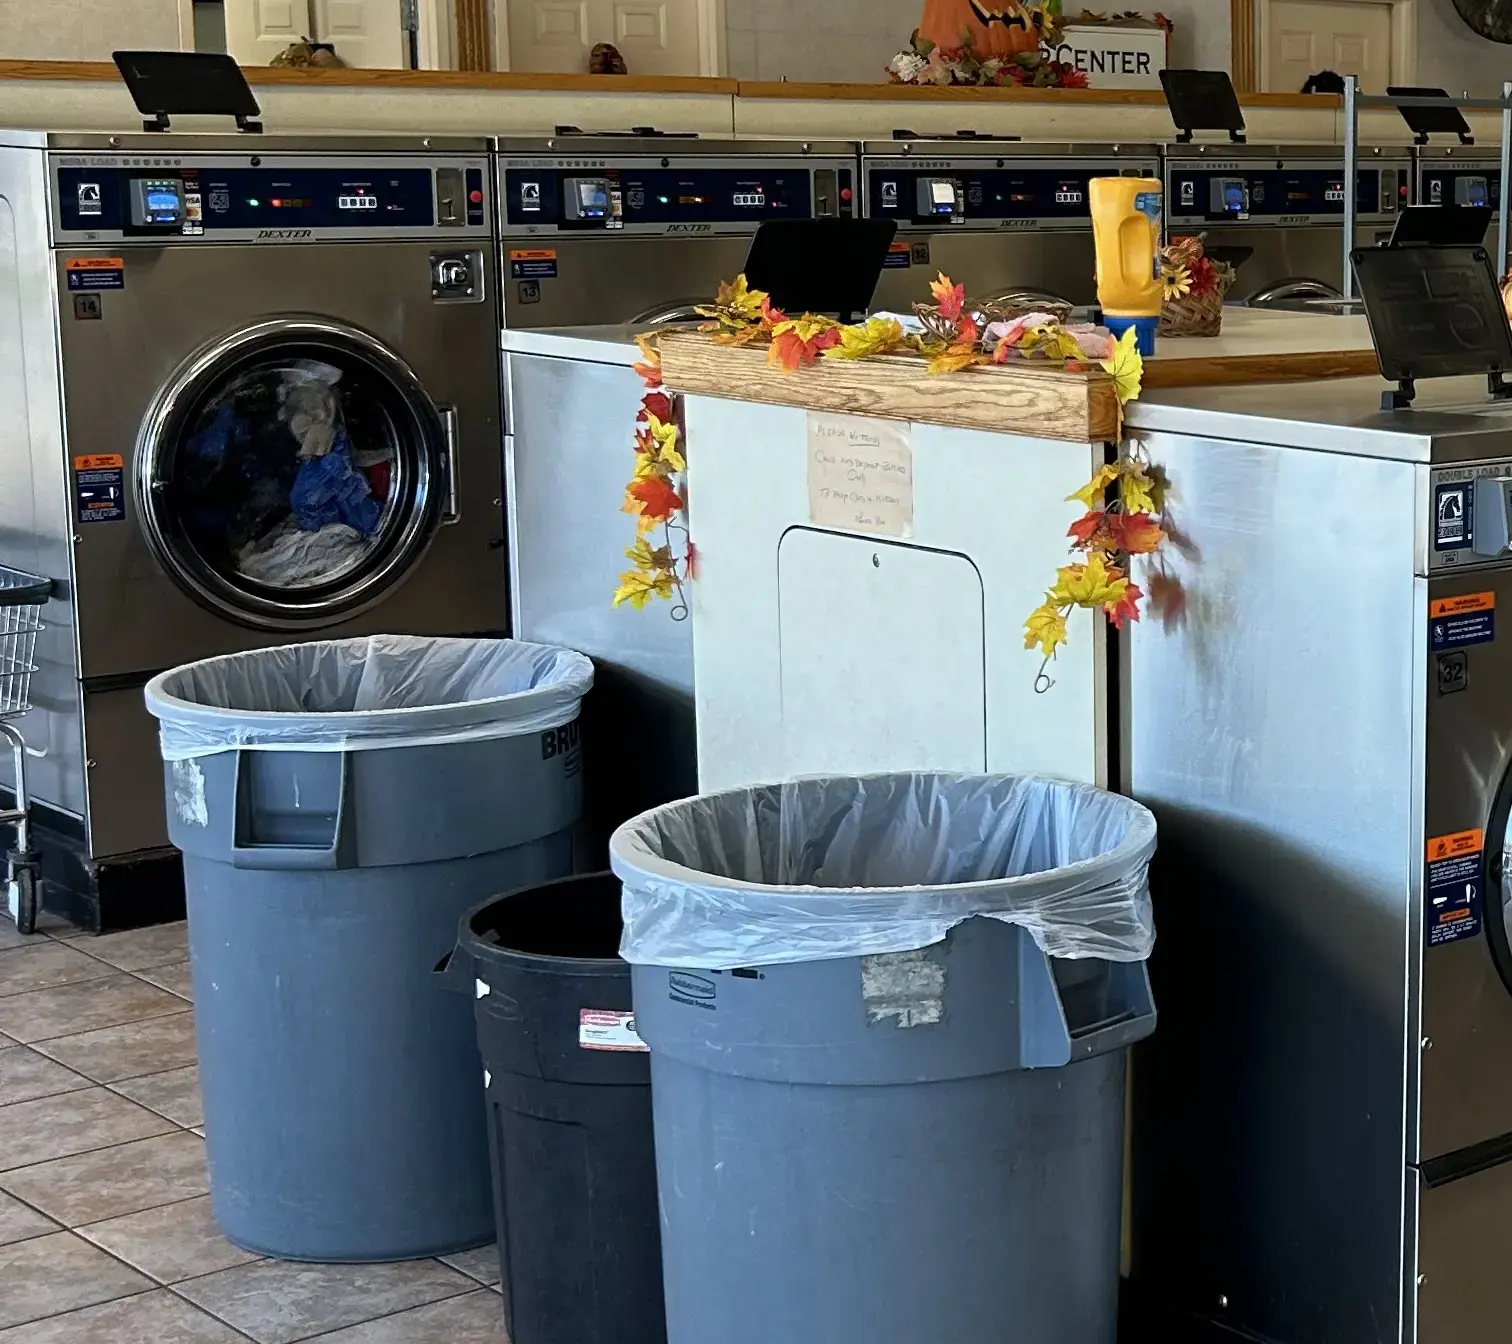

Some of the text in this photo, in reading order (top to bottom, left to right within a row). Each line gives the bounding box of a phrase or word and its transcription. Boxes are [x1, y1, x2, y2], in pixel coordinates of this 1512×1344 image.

[1056, 44, 1151, 75] CENTER
[258, 229, 312, 240] DEXTER
[666, 224, 712, 233] DEXTER
[522, 286, 537, 298] 13
[80, 300, 97, 314] 14
[1438, 467, 1474, 482] DOUBLE
[1443, 661, 1463, 683] 32
